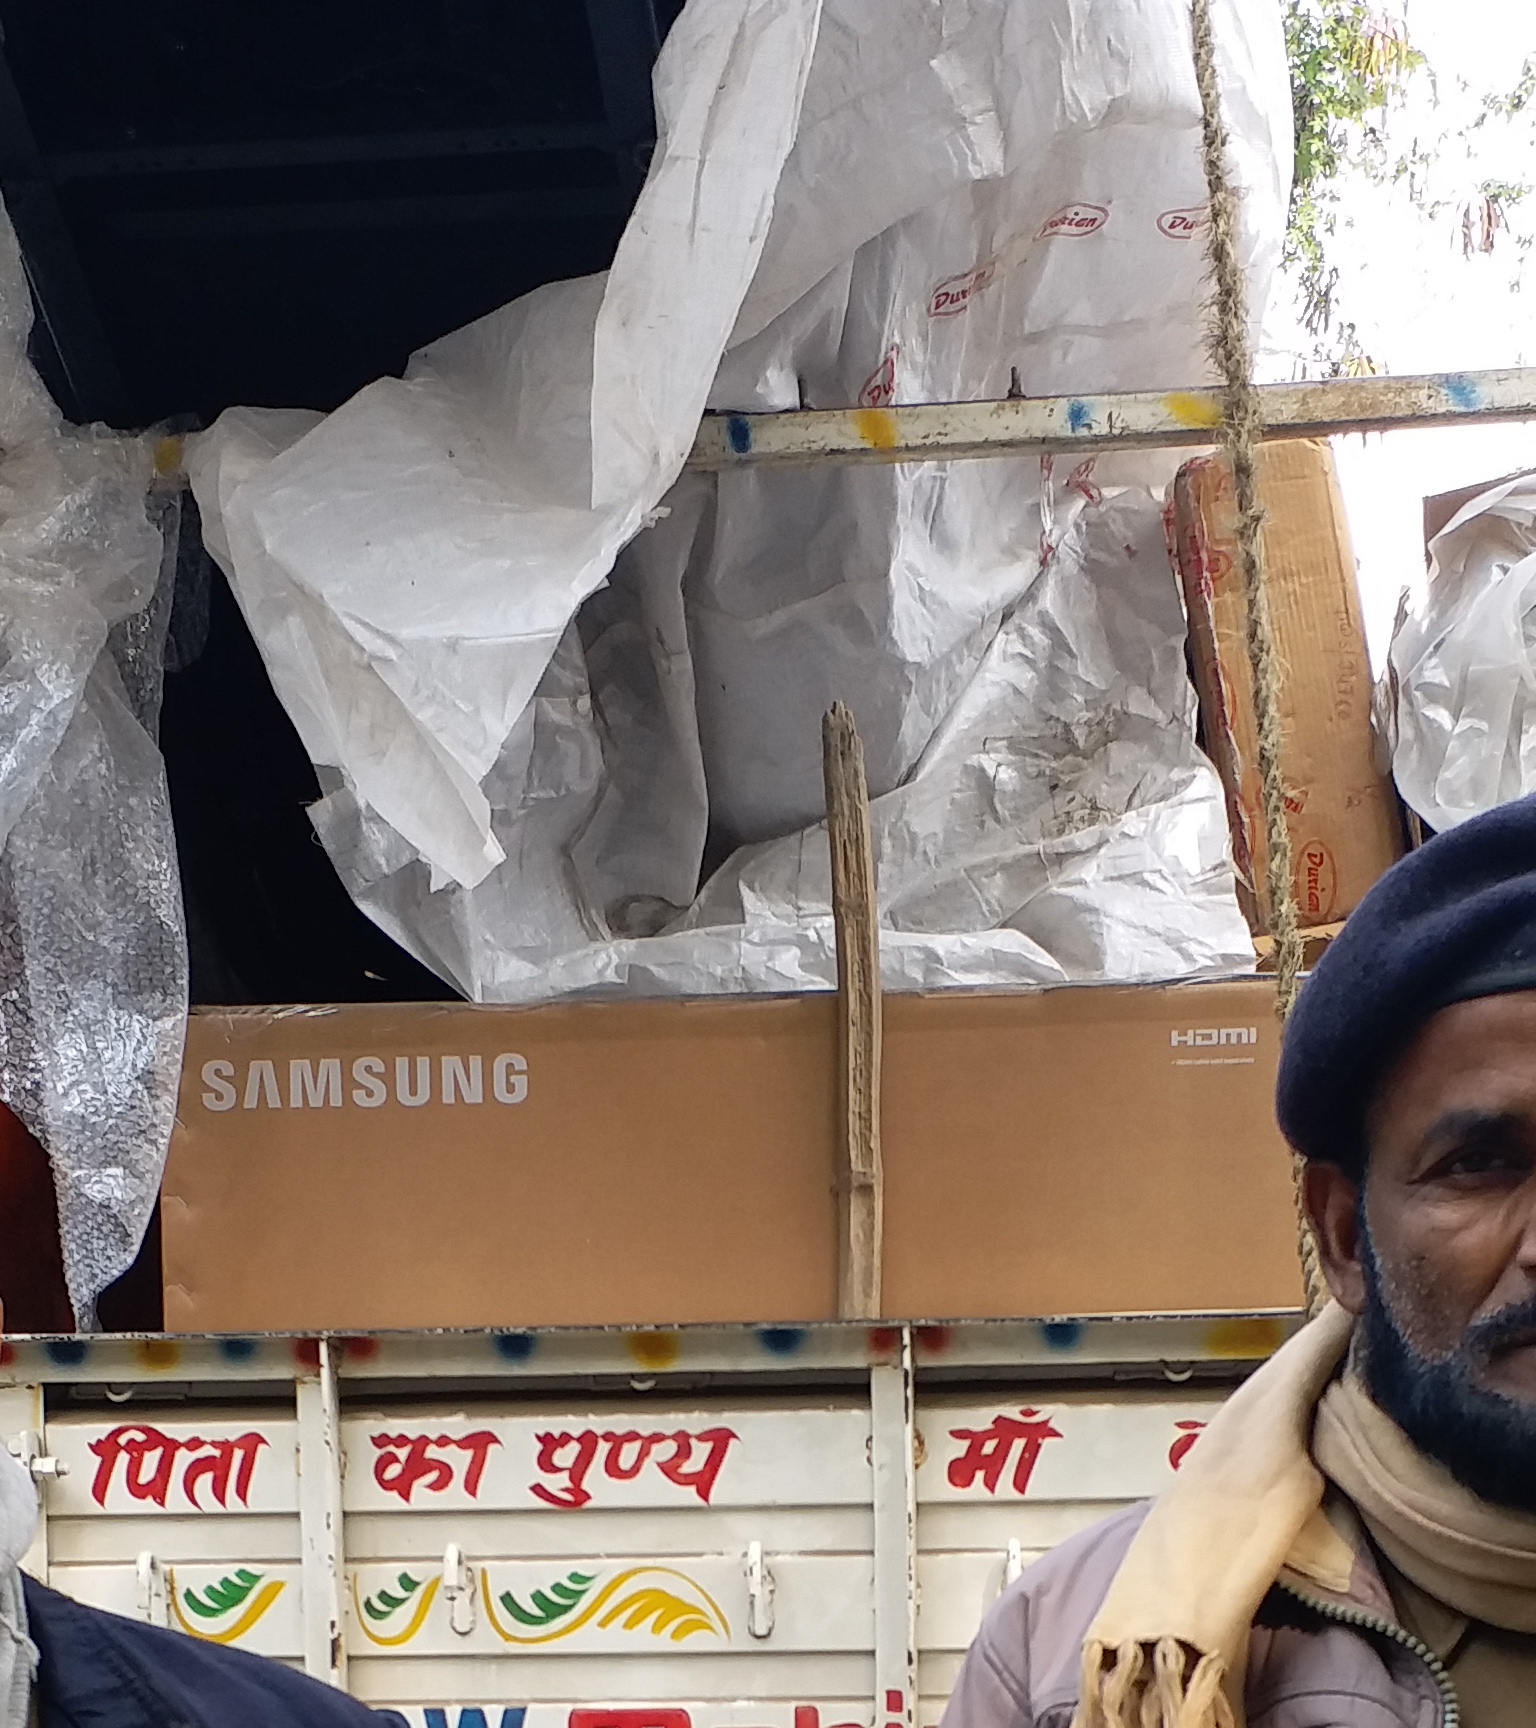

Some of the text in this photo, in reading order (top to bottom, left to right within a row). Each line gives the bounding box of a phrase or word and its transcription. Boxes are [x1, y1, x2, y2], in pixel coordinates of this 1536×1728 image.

[1306, 851, 1326, 914] Durian
[1170, 1027, 1257, 1047] HDMI
[201, 1052, 528, 1111] SAMSUNG
[87, 1425, 271, 1513] पिता
[370, 1430, 504, 1505] का
[529, 1426, 742, 1509] पुण्य
